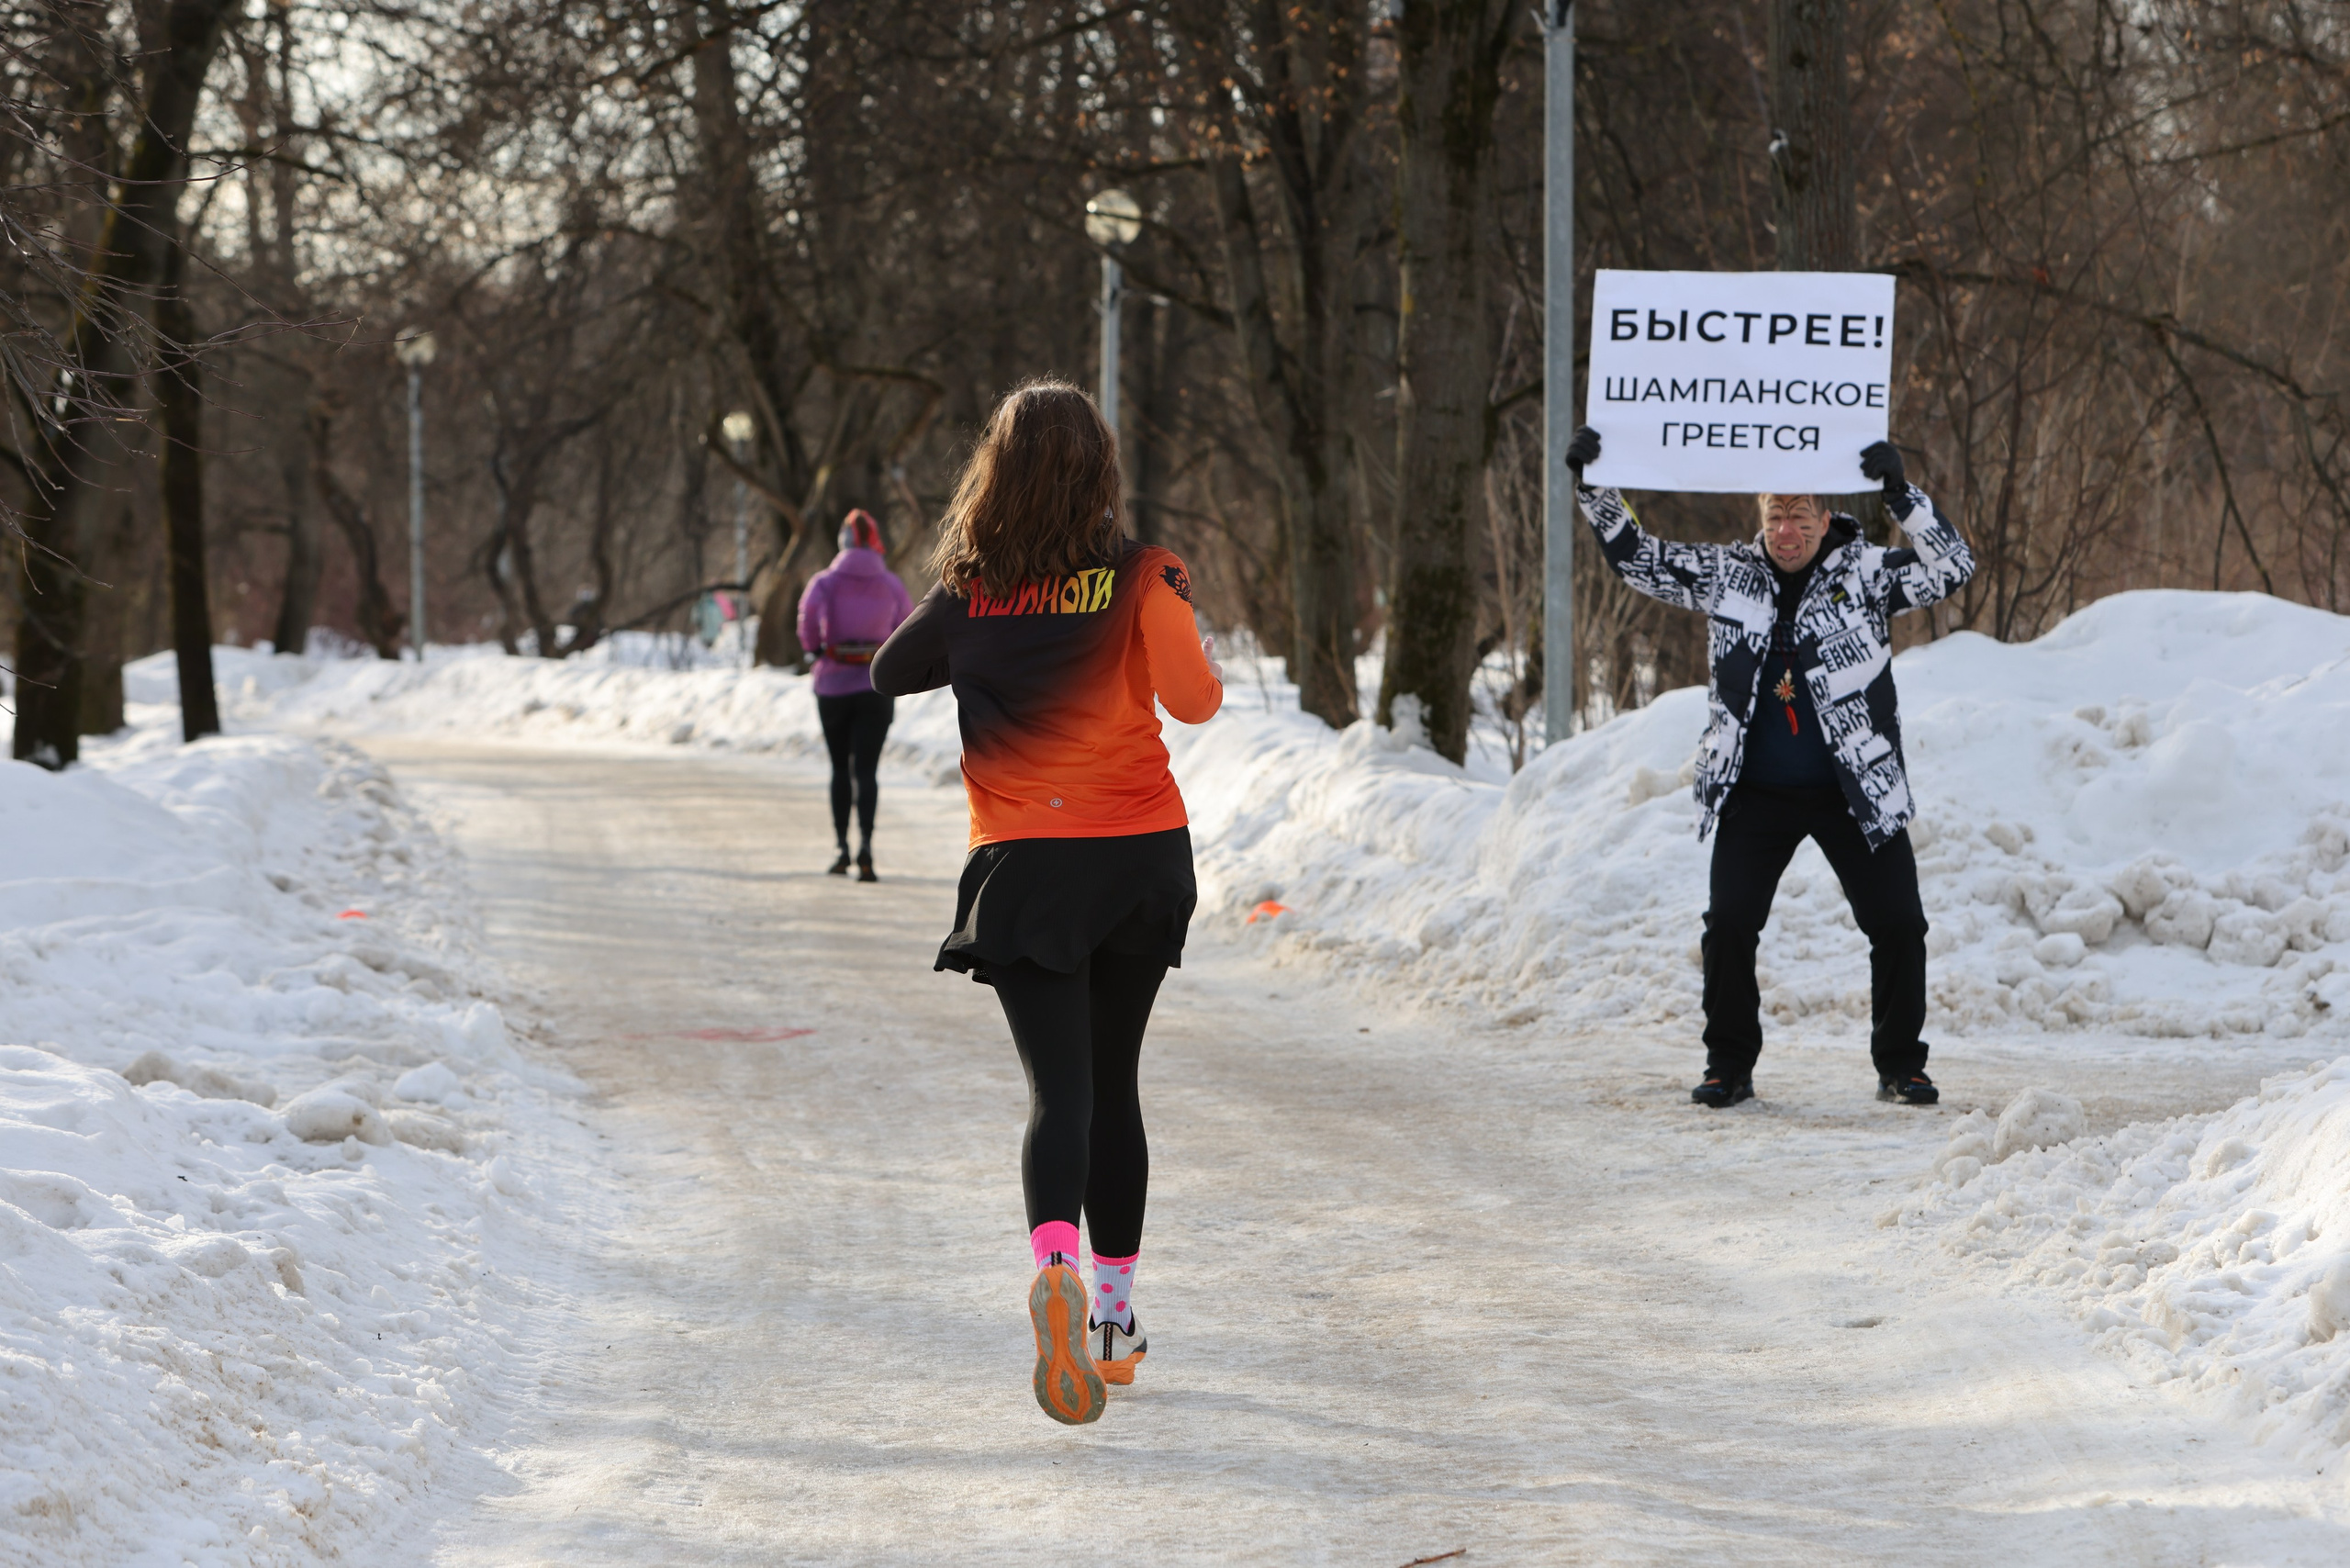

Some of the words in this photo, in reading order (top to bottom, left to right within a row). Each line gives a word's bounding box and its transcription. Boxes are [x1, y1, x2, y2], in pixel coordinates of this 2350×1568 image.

[1611, 309, 1883, 348] БЫСТРЕЕ!
[1606, 377, 1885, 408] ШАМПАНСКОЕ
[1662, 423, 1819, 450] ГРЕЕТСЯ
